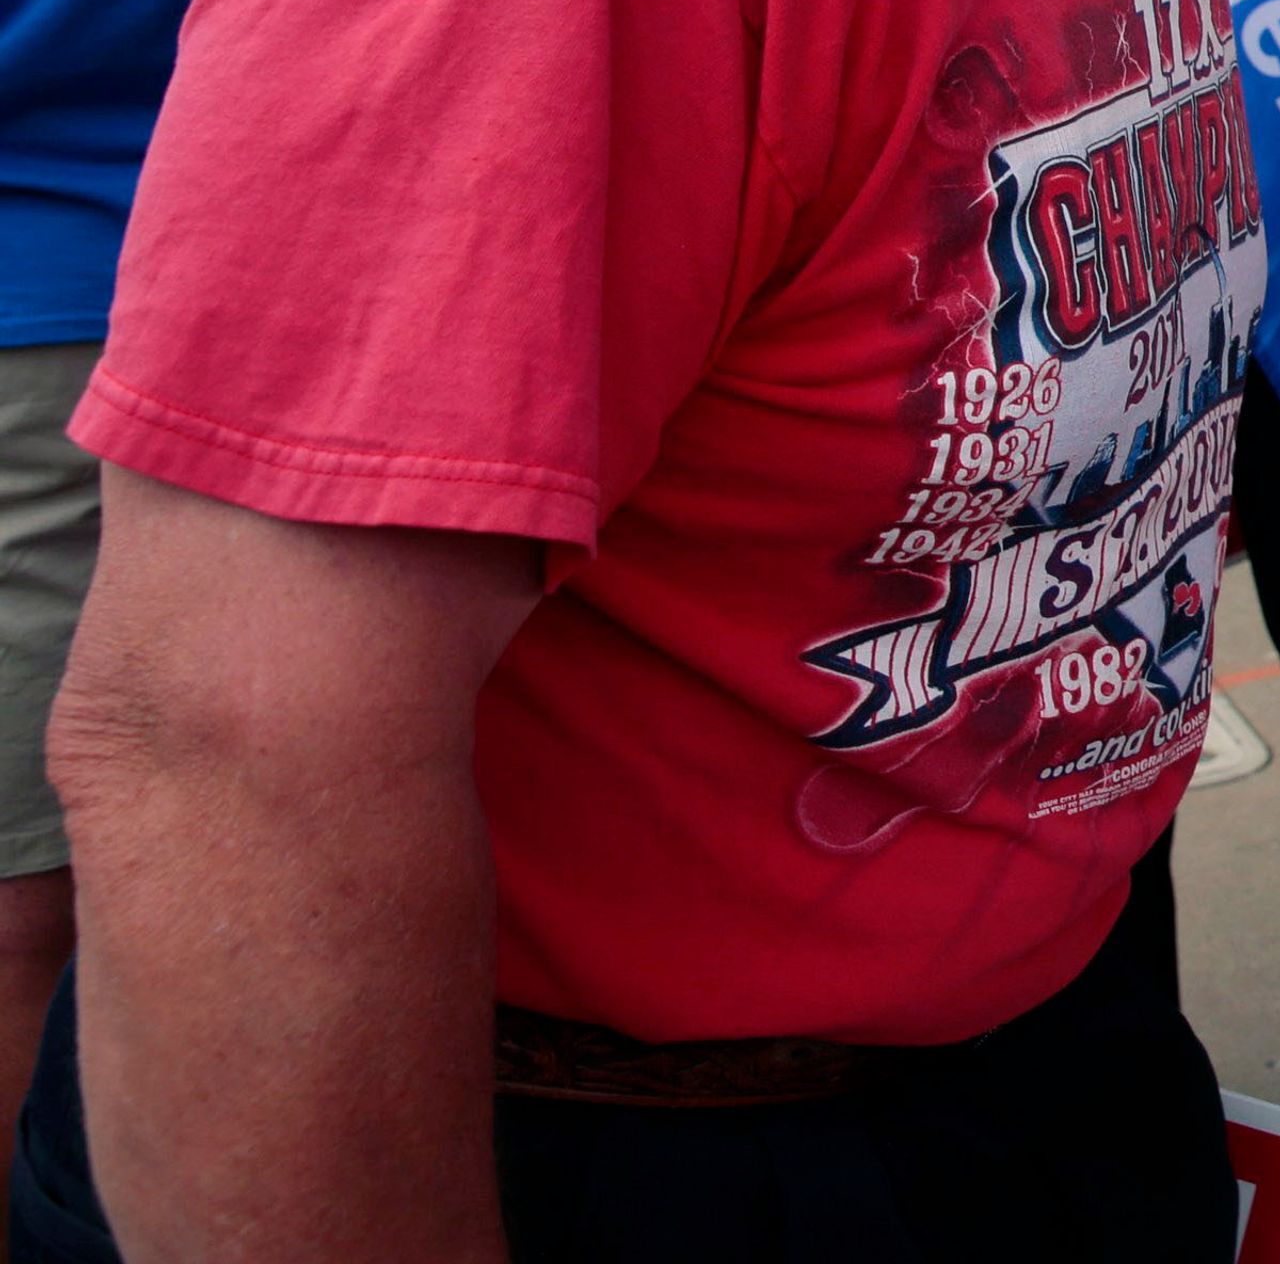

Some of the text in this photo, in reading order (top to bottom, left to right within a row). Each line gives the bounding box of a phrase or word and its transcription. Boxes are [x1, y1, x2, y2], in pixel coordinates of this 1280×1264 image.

[937, 357, 1061, 426] 1926
[921, 421, 1053, 486] 1931
[902, 478, 1037, 524] 1934
[864, 522, 1002, 564] 1942
[1035, 638, 1147, 719] 1982
